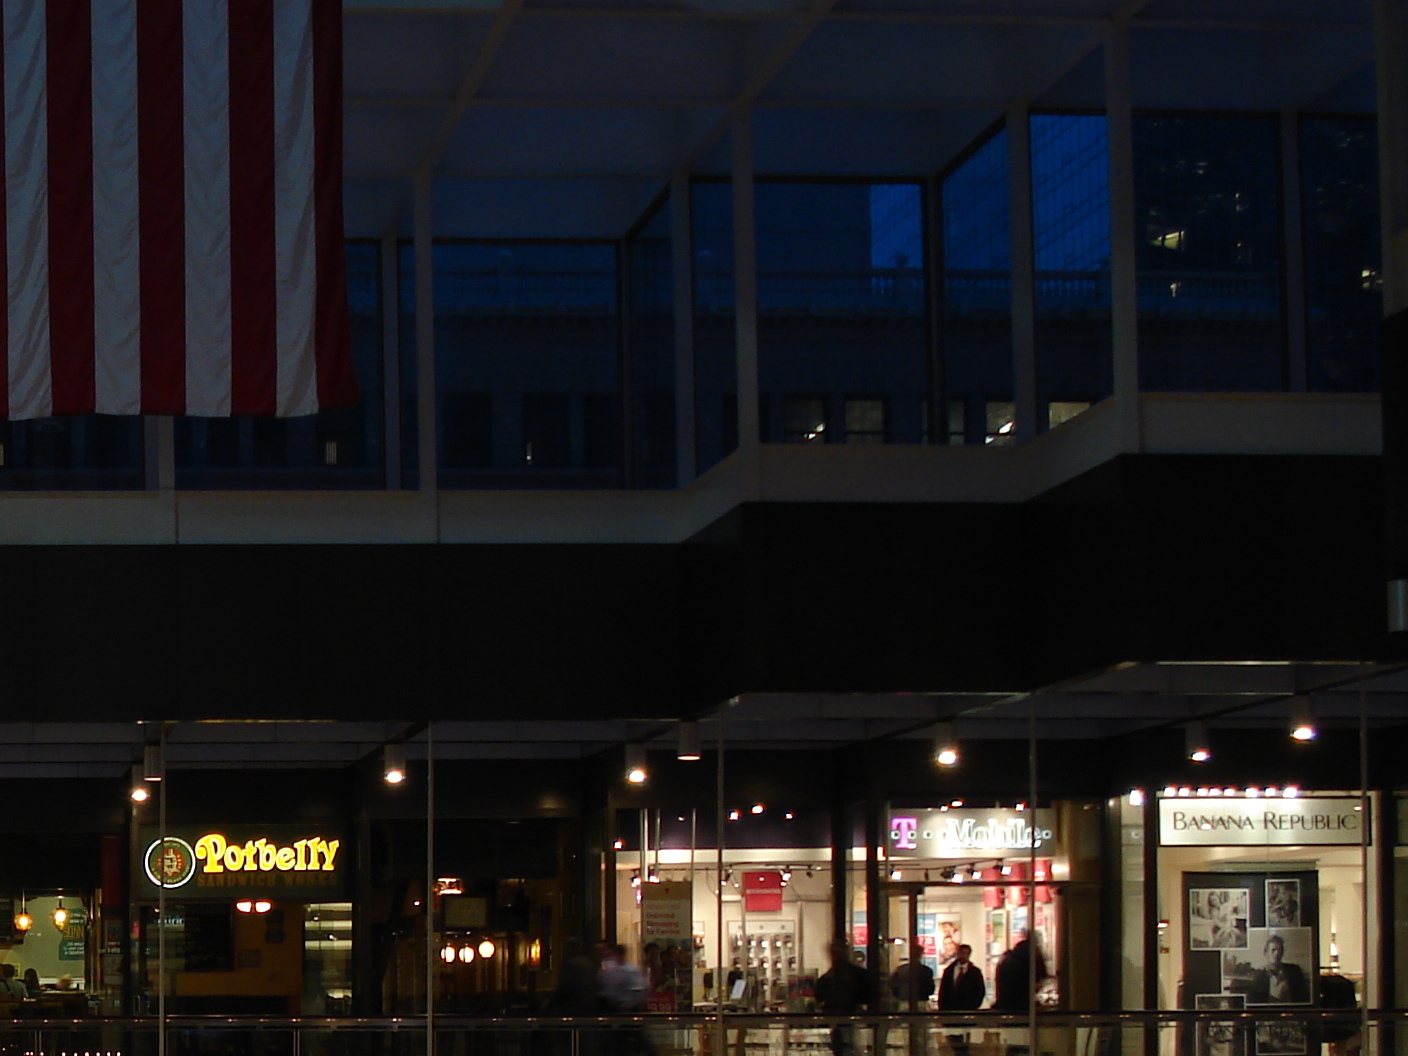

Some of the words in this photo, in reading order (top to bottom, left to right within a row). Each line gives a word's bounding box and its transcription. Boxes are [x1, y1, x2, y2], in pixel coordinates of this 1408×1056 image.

[1172, 810, 1255, 831] BANANA
[1263, 810, 1358, 831] REPUBLIC
[194, 833, 340, 873] Potbelly
[197, 874, 276, 887] SANDWICH
[282, 874, 337, 887] WORKS
